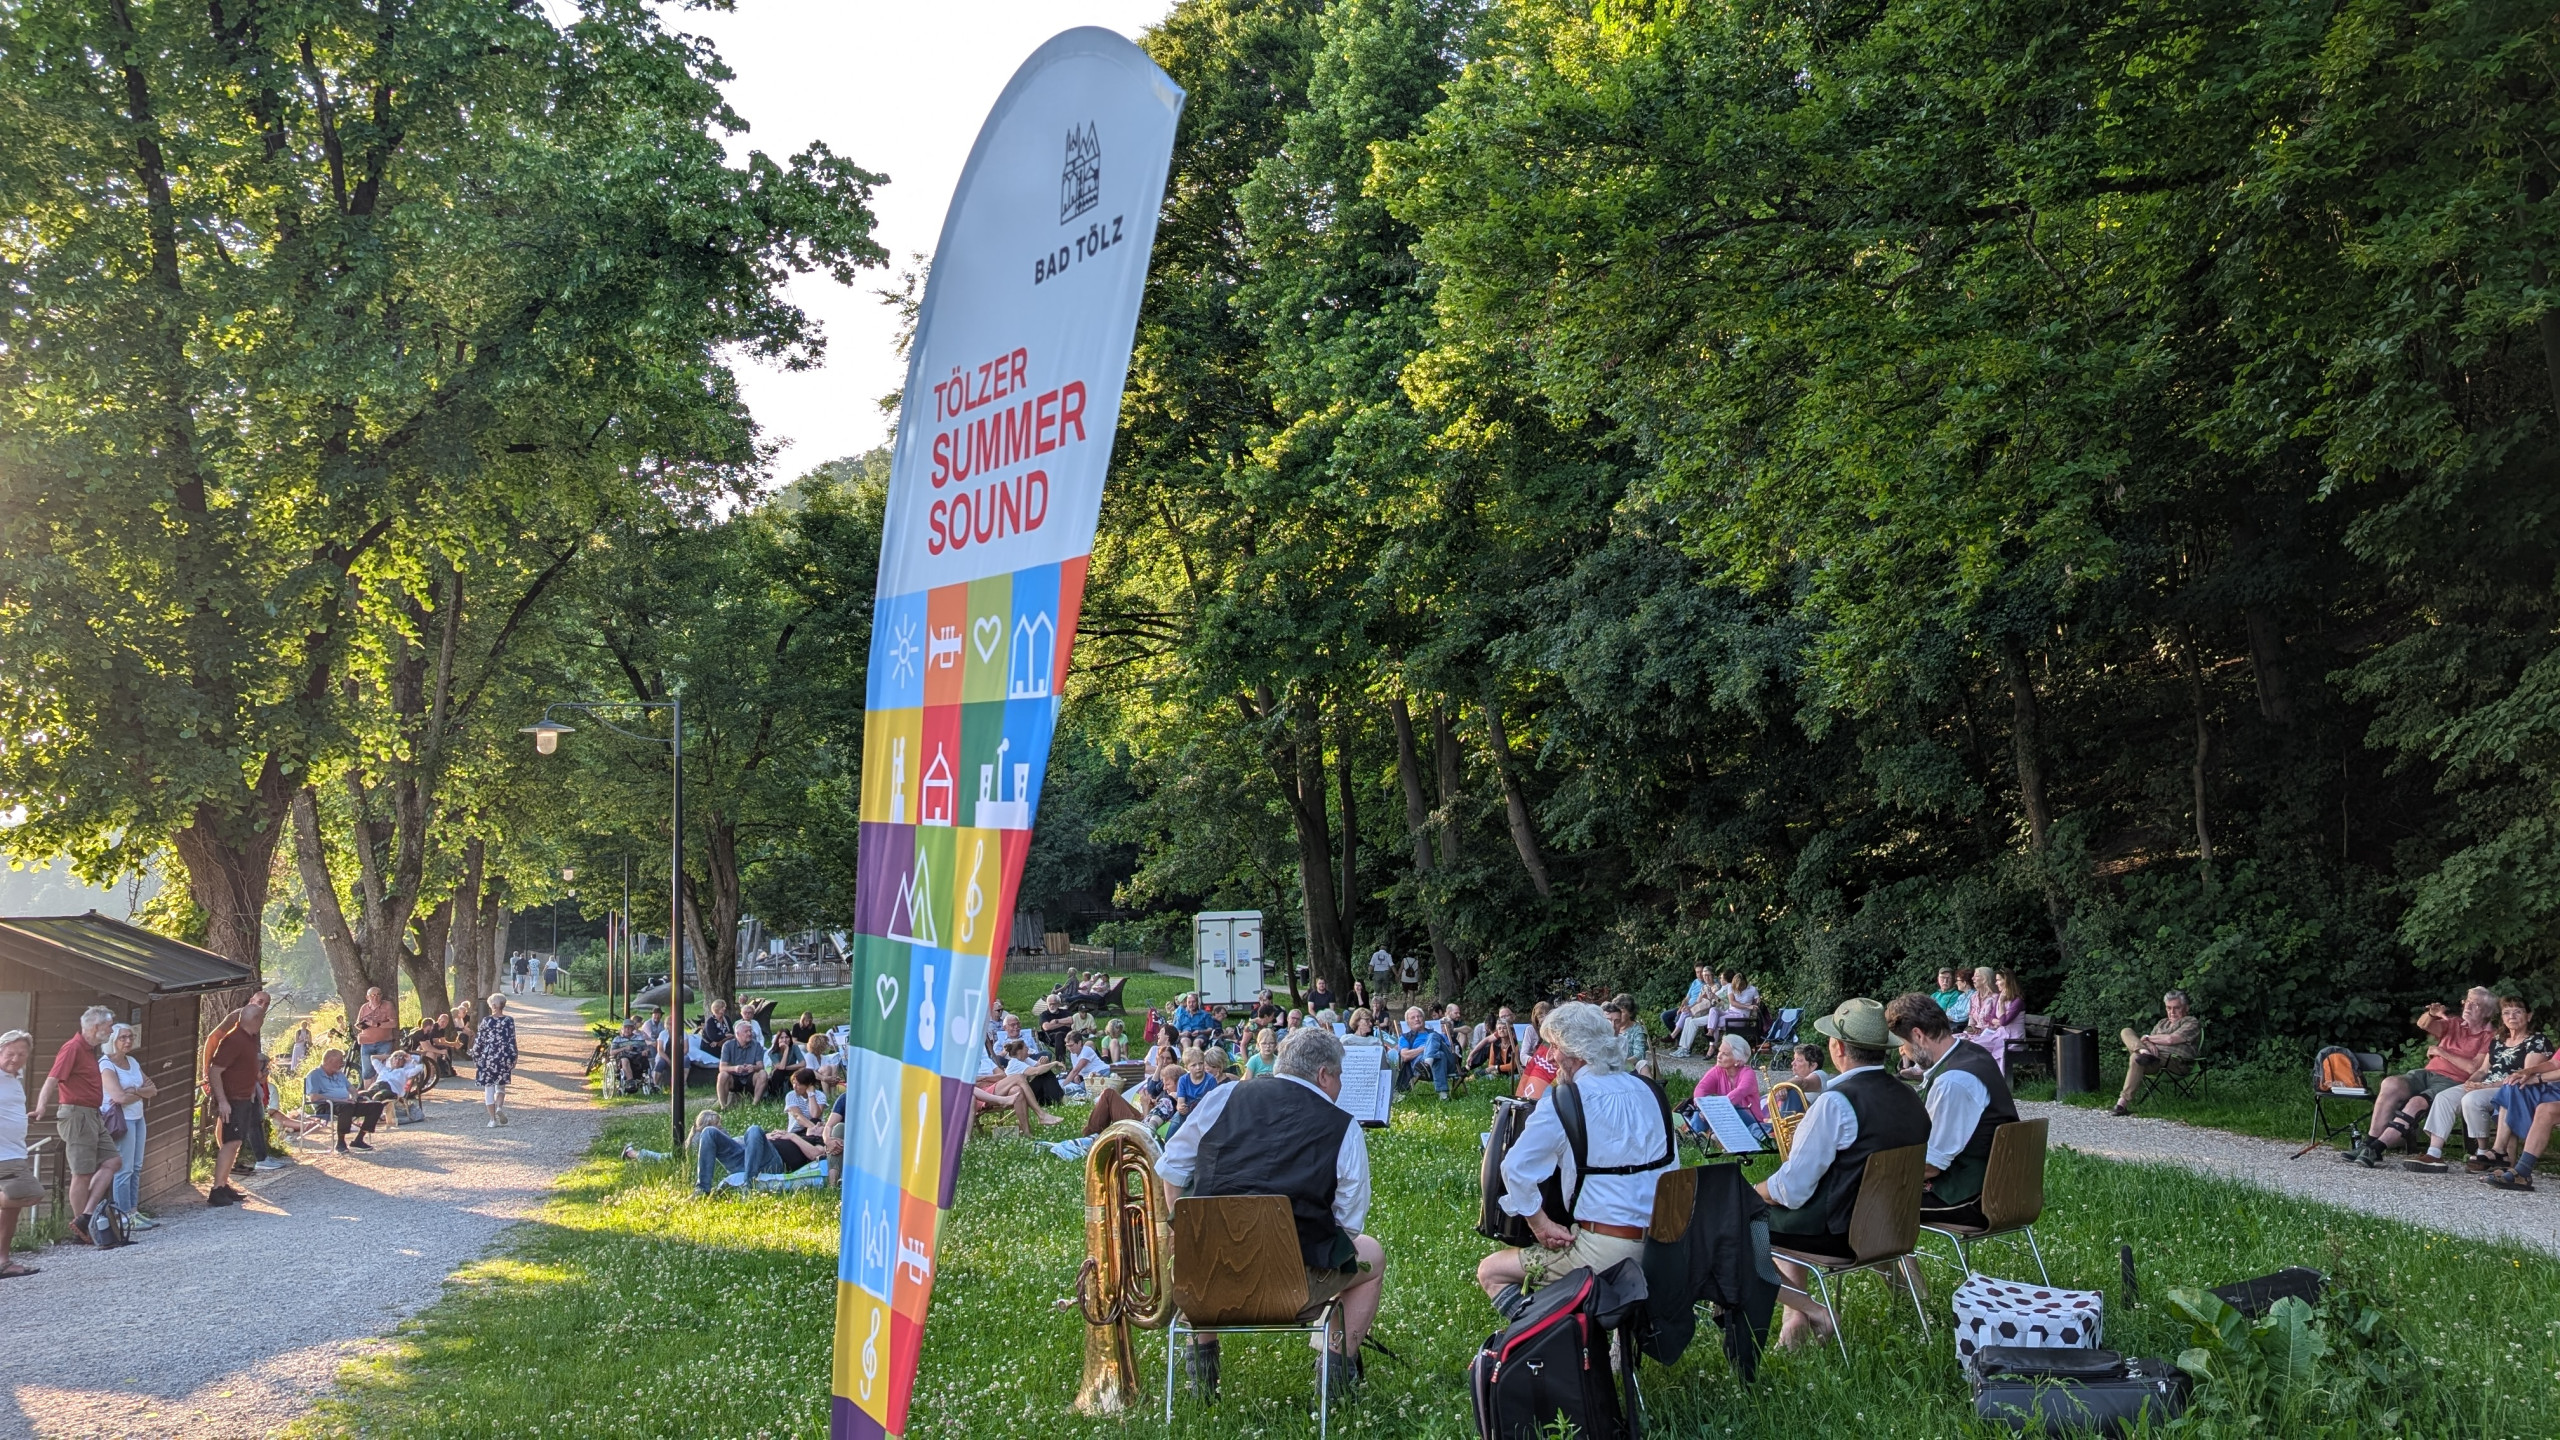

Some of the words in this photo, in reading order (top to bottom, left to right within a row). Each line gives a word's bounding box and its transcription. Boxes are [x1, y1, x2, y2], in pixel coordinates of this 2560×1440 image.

[1035, 246, 1070, 285] BAD
[1076, 214, 1124, 263] TÖLZ
[934, 346, 1028, 423] TÖLZER
[931, 380, 1087, 489] SUMMER
[928, 469, 1048, 556] SOUND
